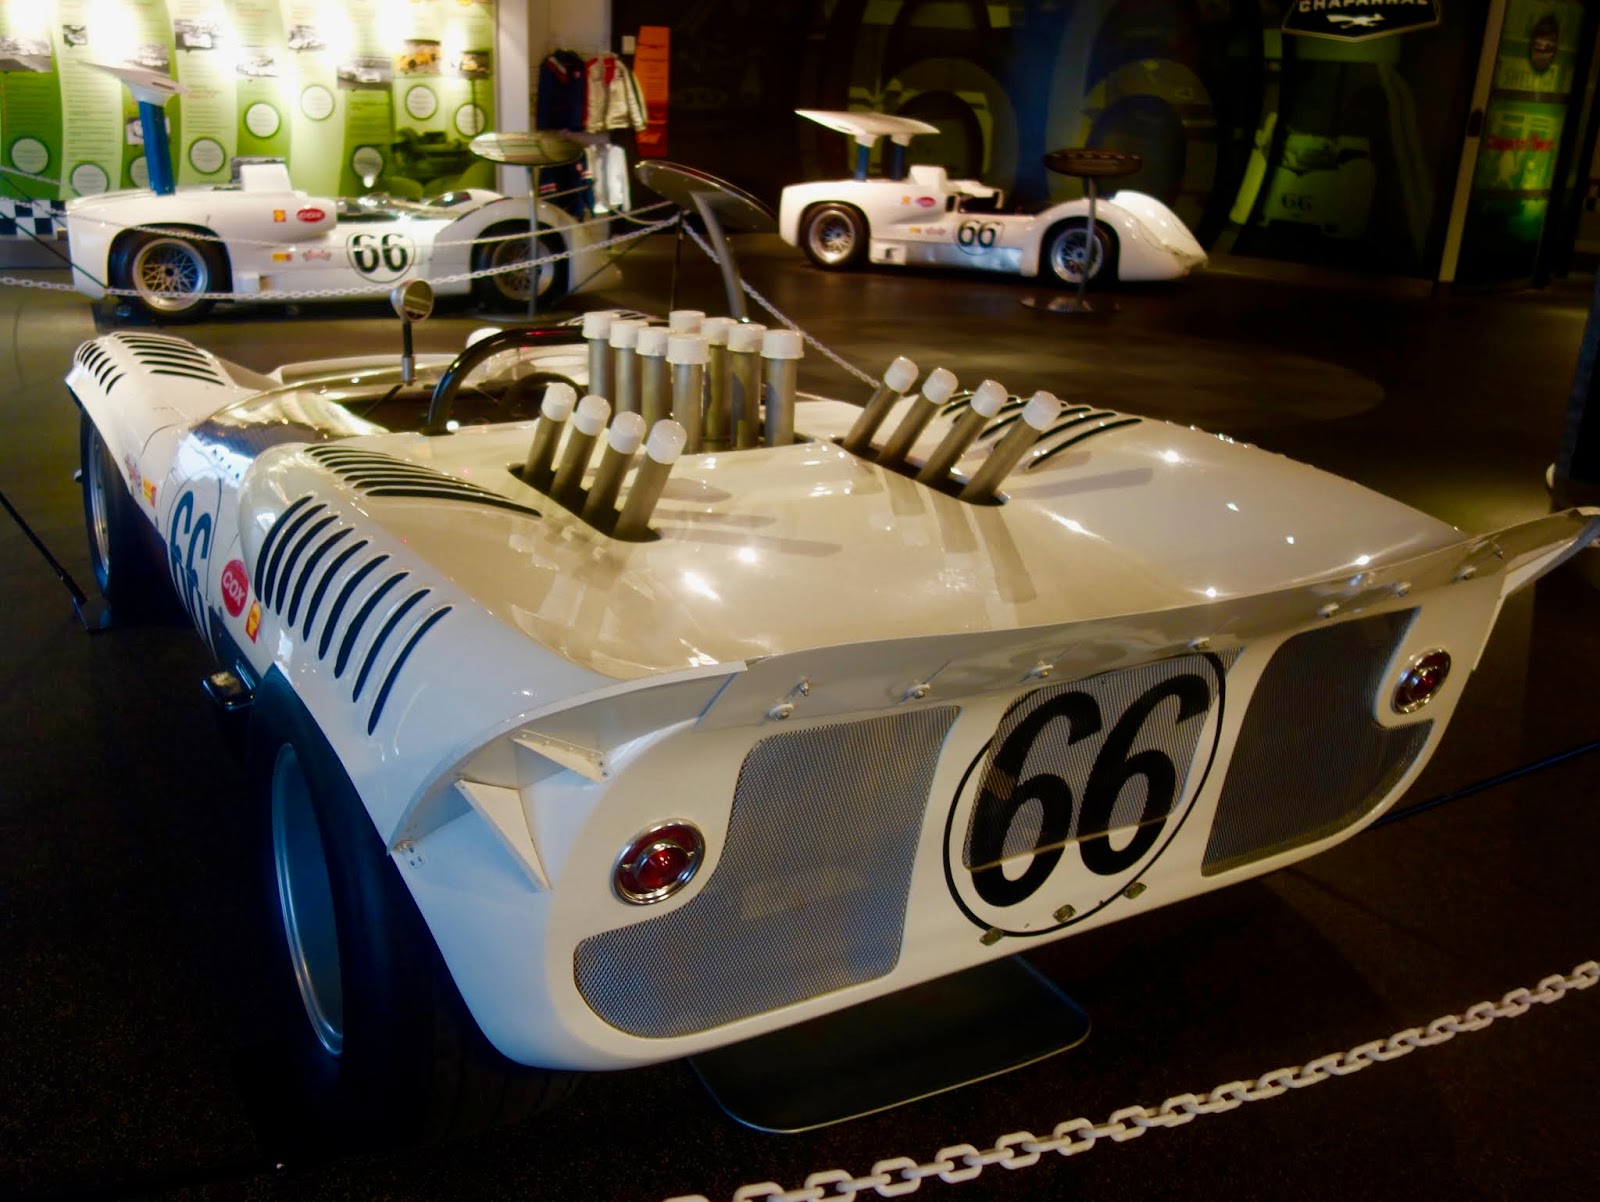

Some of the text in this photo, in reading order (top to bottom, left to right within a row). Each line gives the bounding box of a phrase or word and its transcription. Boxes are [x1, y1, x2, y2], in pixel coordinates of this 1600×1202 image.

[352, 233, 408, 273] 66
[957, 220, 1001, 248] 66
[169, 490, 213, 642] 66
[223, 570, 247, 607] COX
[969, 673, 1212, 909] 66
